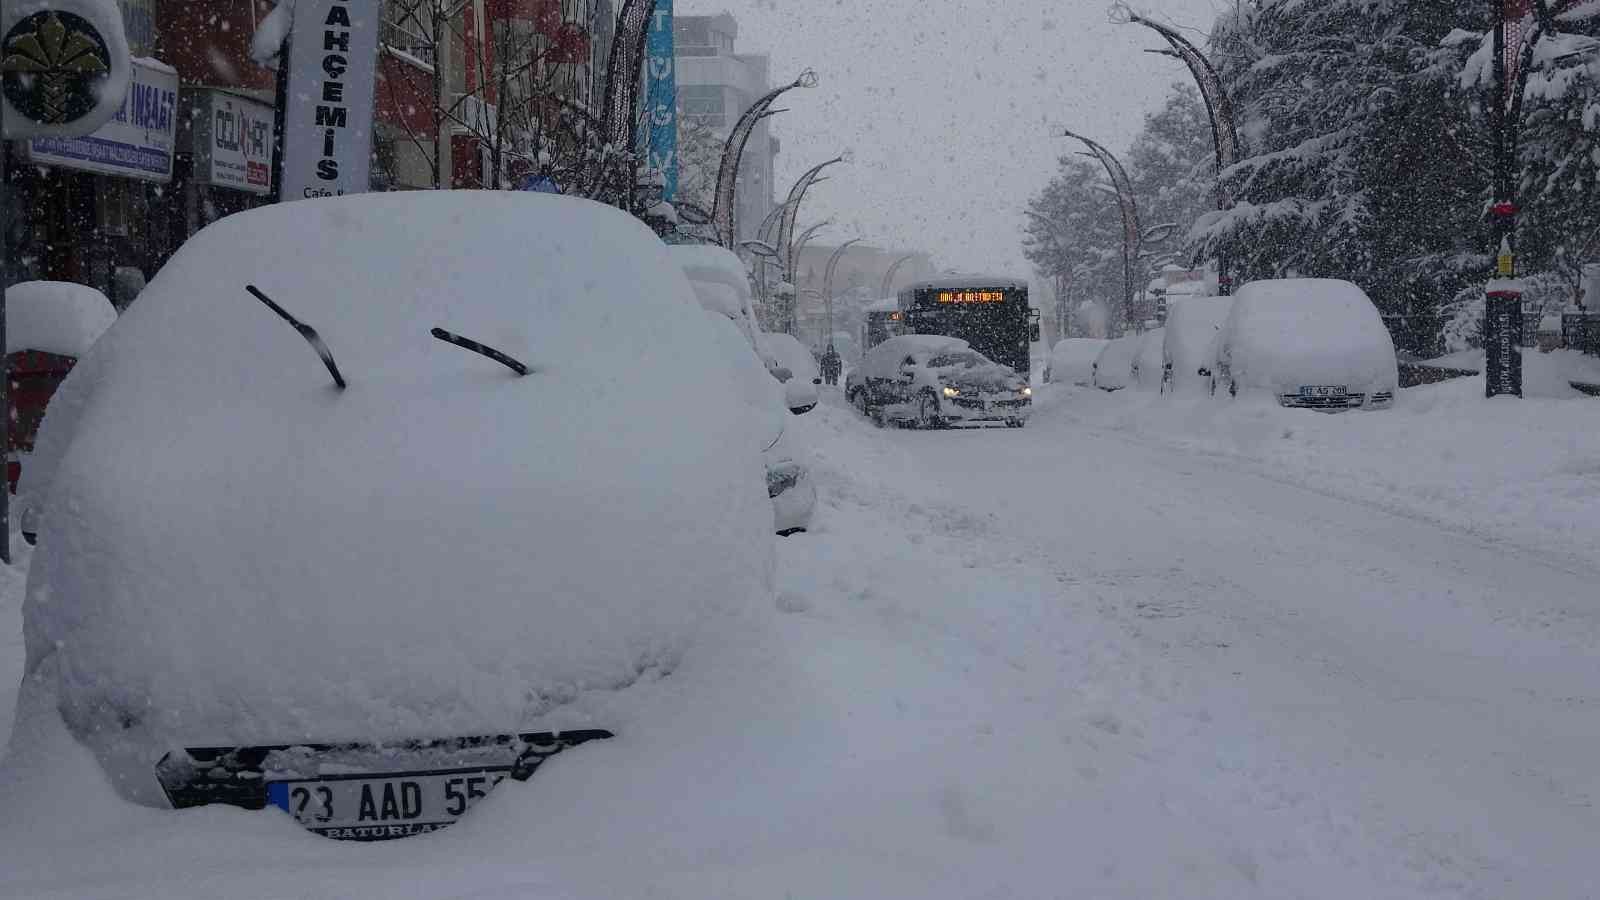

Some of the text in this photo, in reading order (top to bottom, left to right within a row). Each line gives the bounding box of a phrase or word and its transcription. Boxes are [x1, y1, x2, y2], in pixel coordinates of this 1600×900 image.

[315, 0, 351, 181] AHÇEMİS
[291, 776, 504, 822] 23 AAD 55
